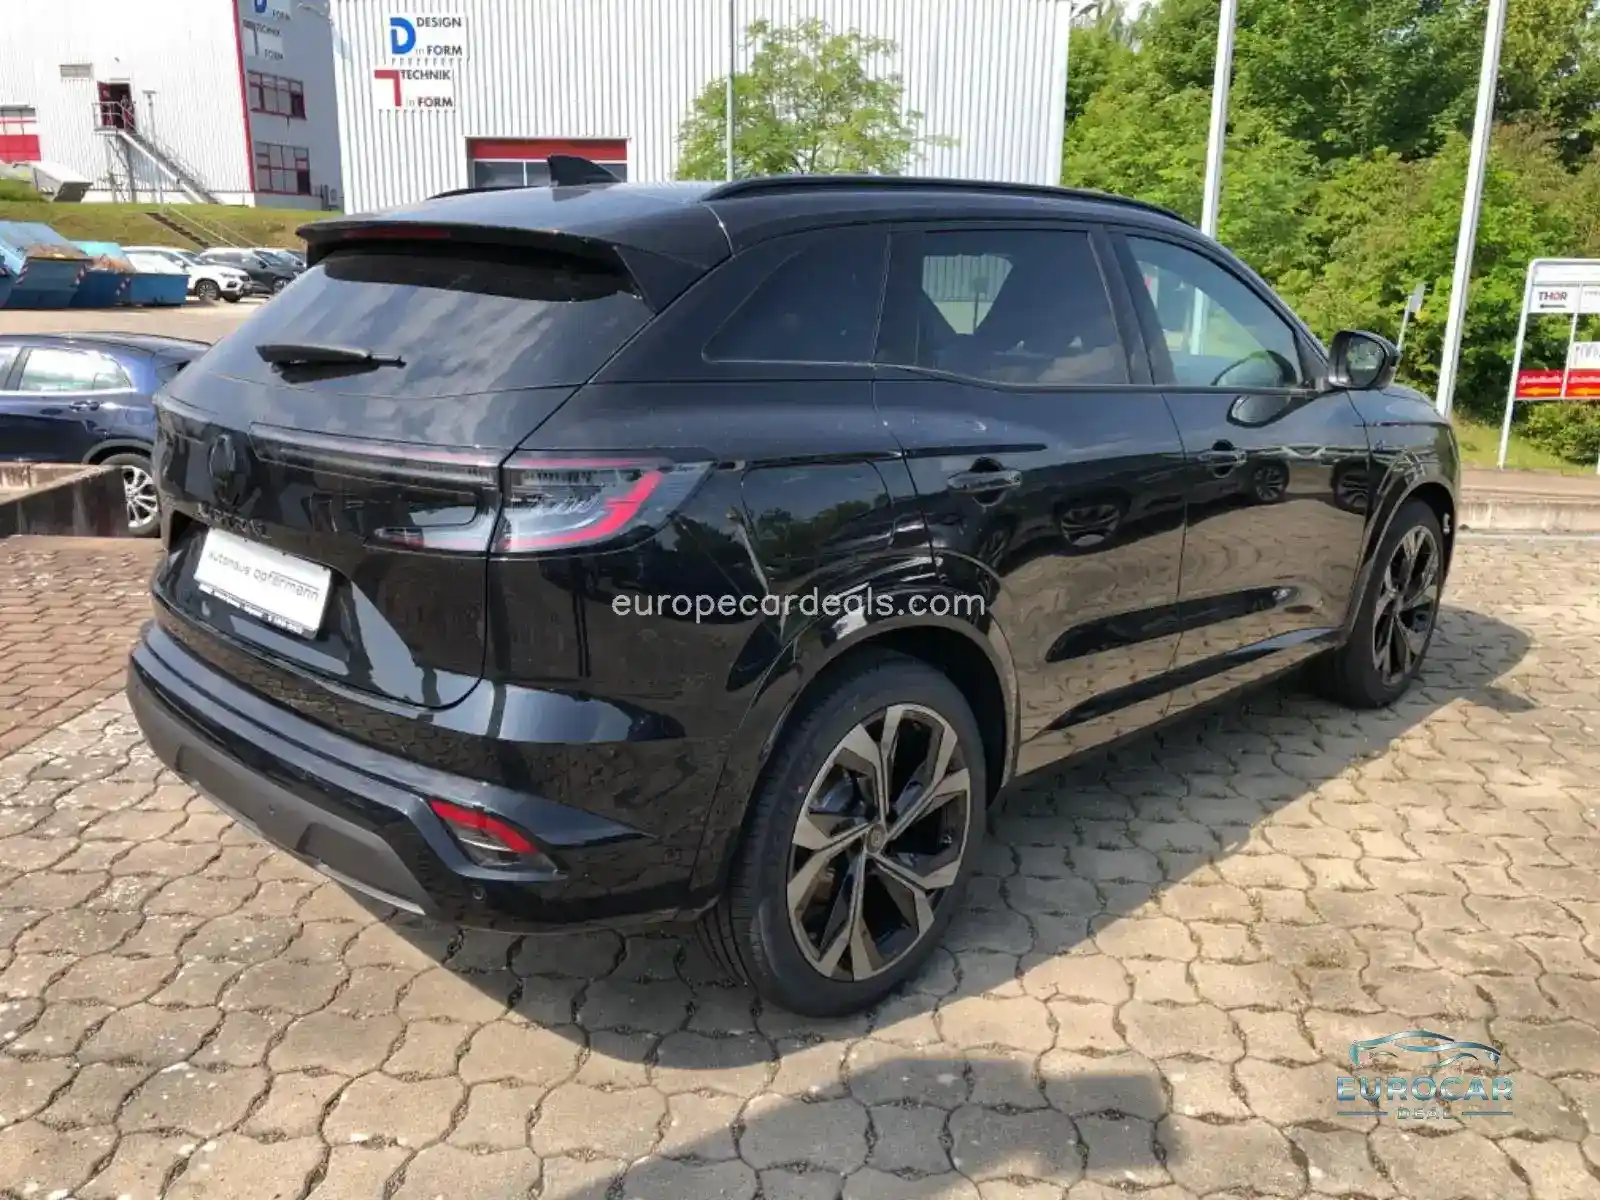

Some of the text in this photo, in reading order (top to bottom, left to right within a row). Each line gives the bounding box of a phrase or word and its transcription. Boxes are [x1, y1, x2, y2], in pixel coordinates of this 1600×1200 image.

[416, 16, 462, 28] DESIGN
[426, 44, 463, 56] FORM
[400, 69, 452, 80] TECHNIK
[417, 96, 454, 108] FORM
